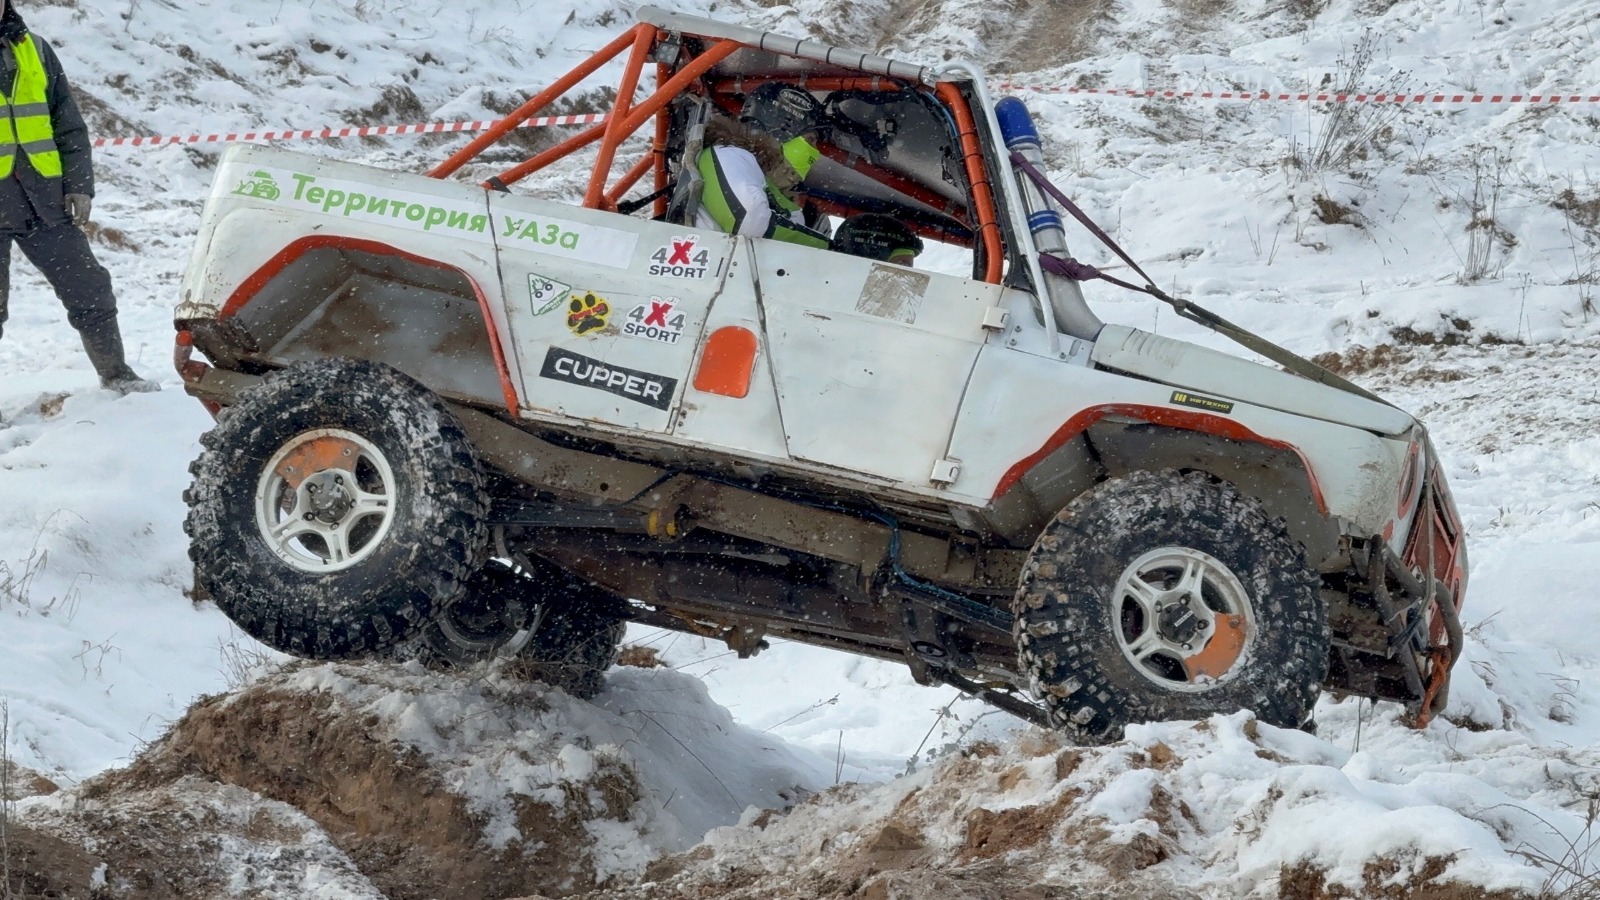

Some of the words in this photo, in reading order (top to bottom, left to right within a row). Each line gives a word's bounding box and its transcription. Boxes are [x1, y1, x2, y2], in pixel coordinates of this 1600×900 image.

[291, 172, 489, 232] Территория
[502, 215, 580, 250] УАЗа
[648, 265, 707, 279] SPORT
[623, 322, 681, 343] SPORT
[553, 356, 663, 401] CUPPER
